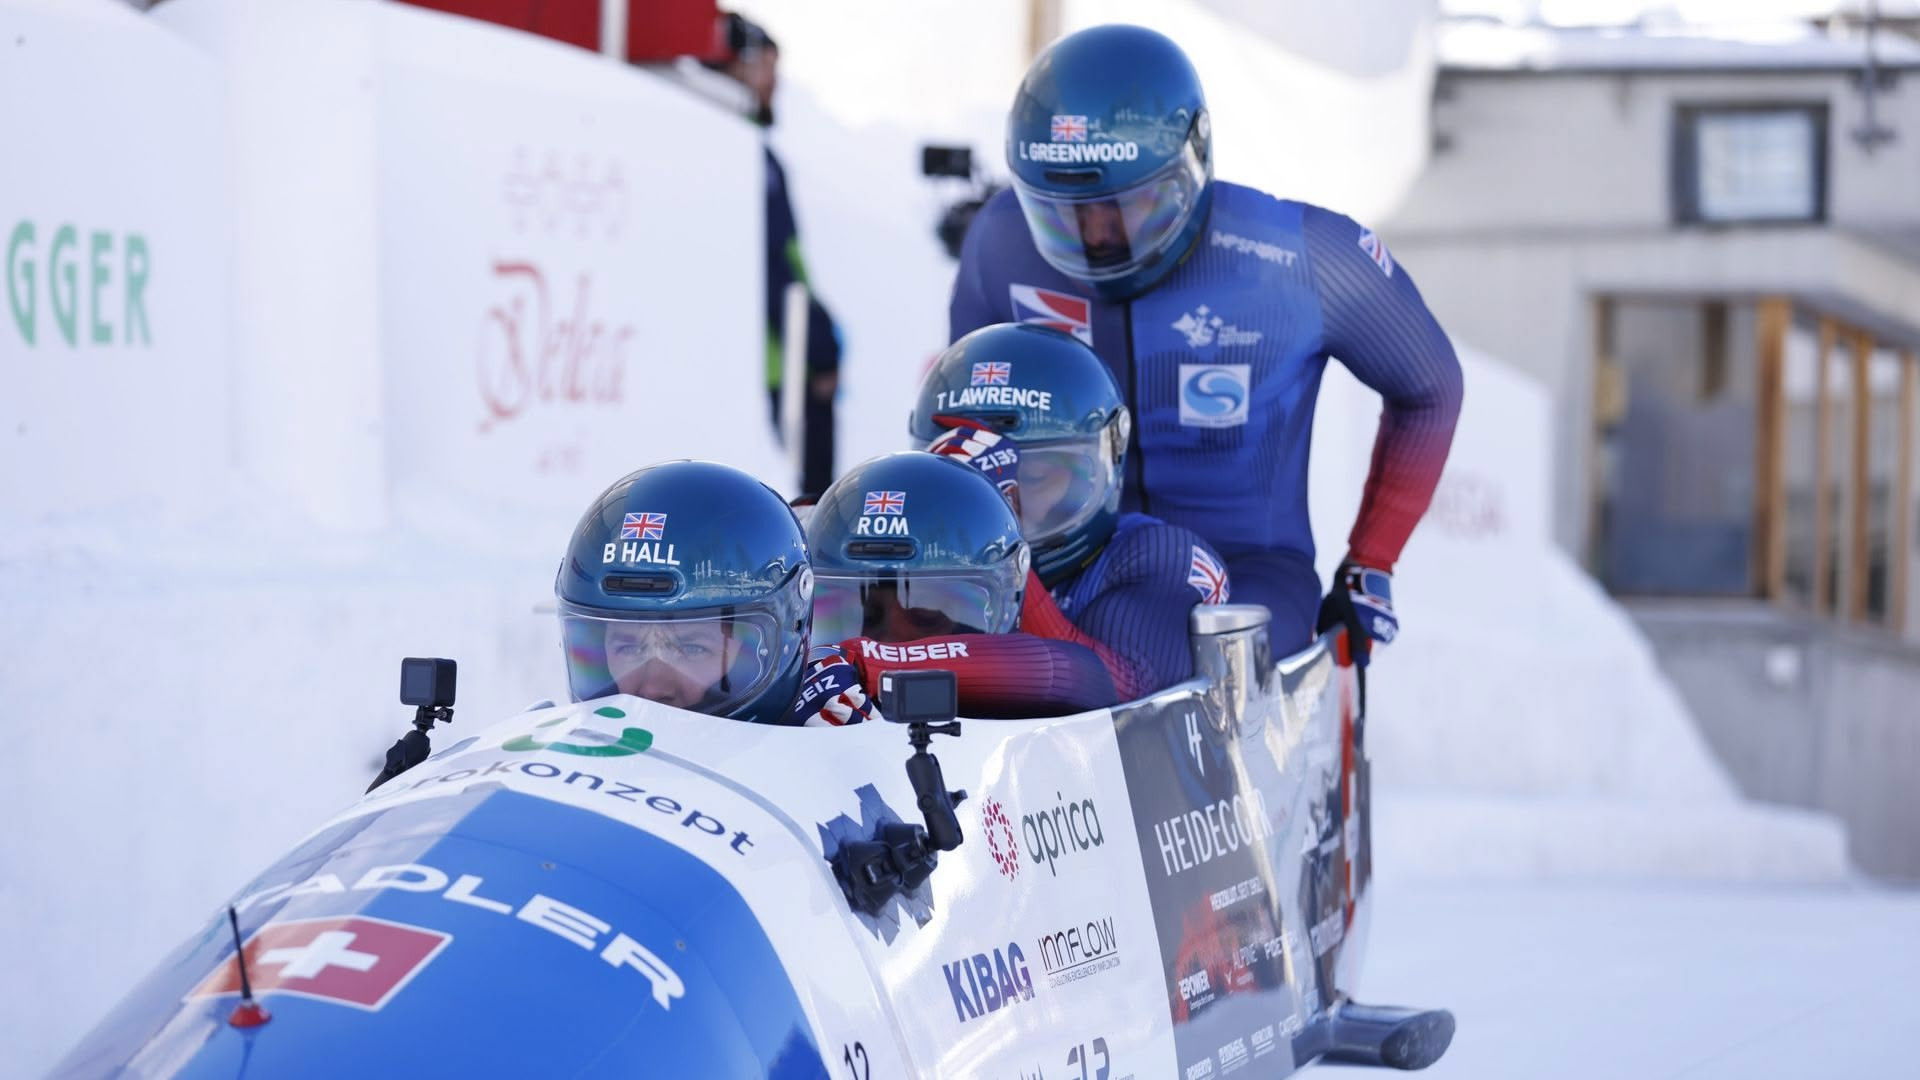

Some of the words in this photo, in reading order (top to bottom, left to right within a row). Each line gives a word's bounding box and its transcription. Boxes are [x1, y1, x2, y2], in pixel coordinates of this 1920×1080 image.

[1019, 141, 1028, 160] L
[1029, 142, 1139, 163] GREENWOOD
[936, 392, 947, 411] T
[948, 386, 1052, 411] LAWRENCE
[975, 448, 1019, 471] SEIZ
[856, 517, 910, 535] ROM
[602, 546, 616, 564] B
[621, 542, 681, 566] HALL
[861, 640, 970, 663] KEISER
[408, 760, 756, 856] rokonzept
[1021, 791, 1105, 877] aprica
[1154, 788, 1274, 877] HEIDEGGR
[942, 942, 1035, 1023] KIBAG
